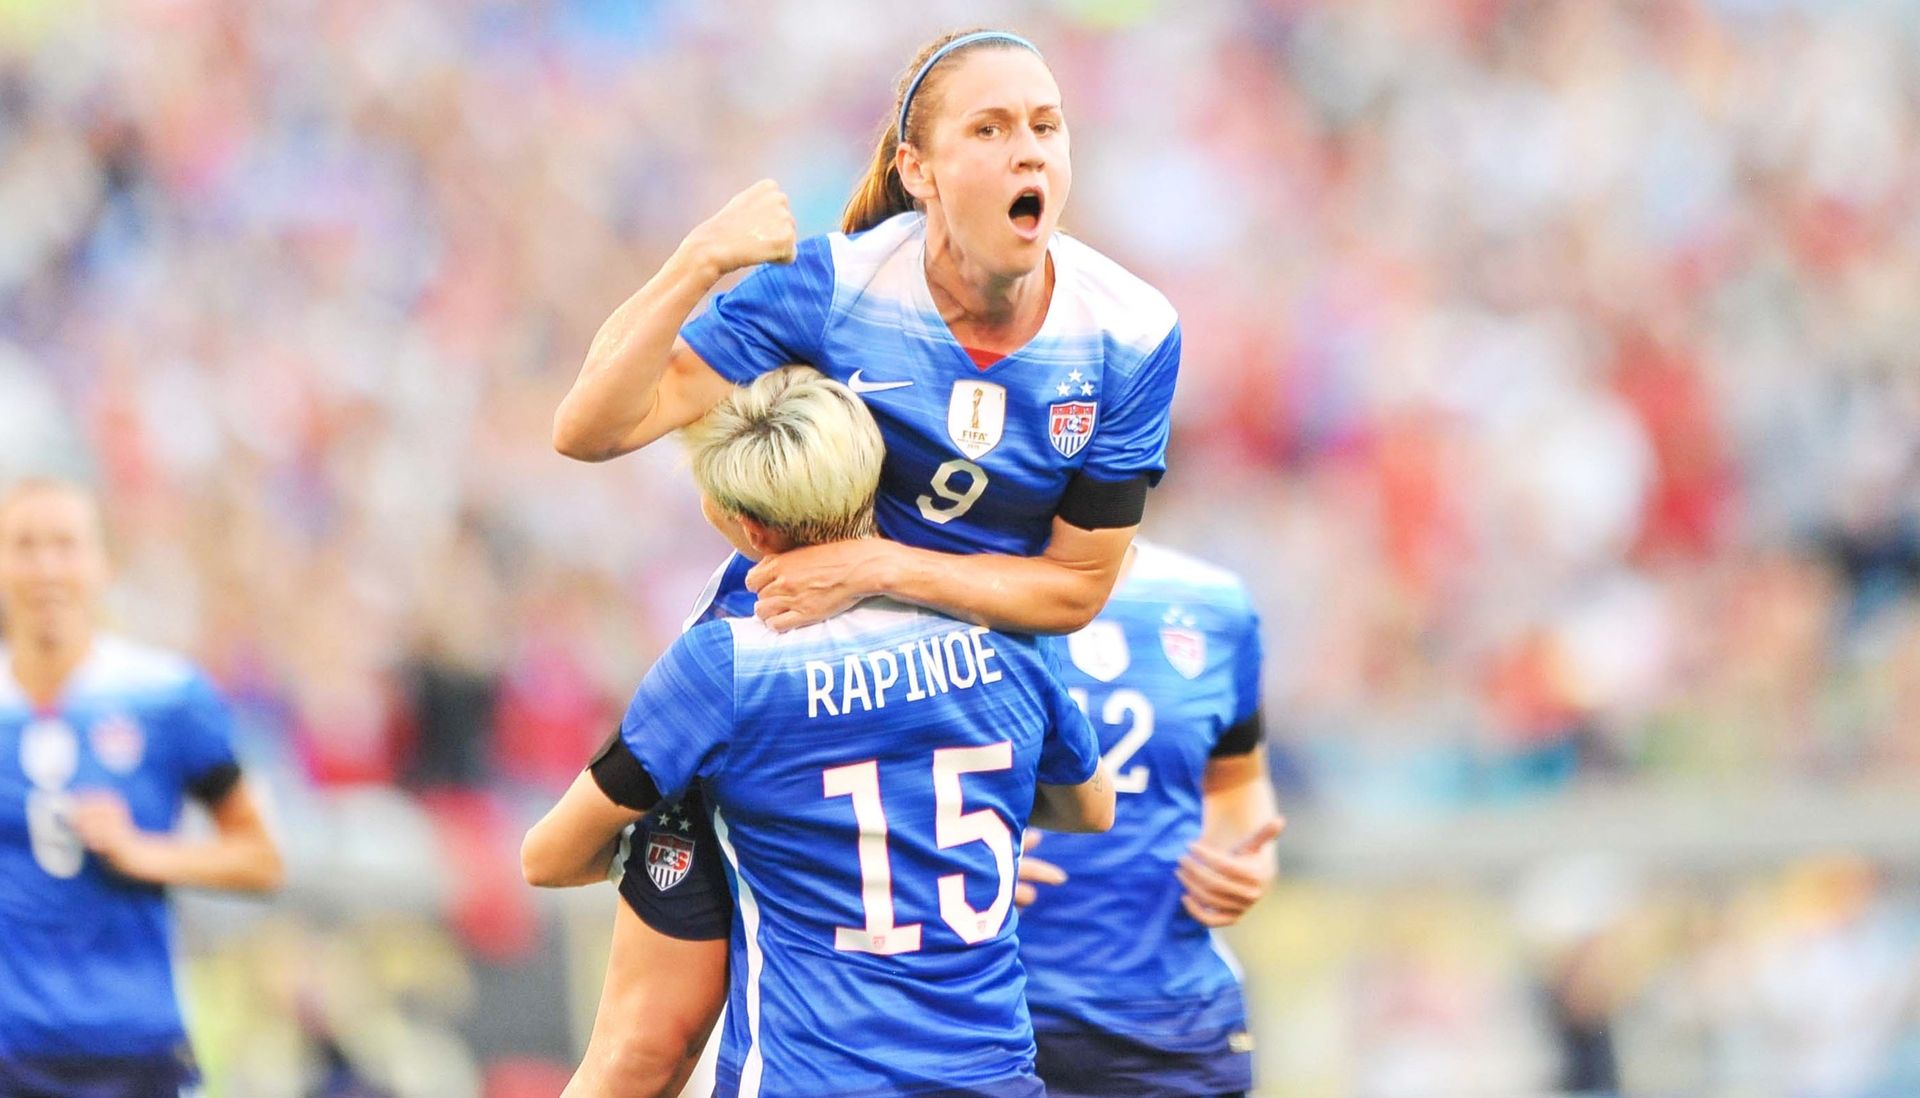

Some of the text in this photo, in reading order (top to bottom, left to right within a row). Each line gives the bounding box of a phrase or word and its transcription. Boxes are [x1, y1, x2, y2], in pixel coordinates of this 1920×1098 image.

[963, 430, 985, 441] FIFA
[916, 458, 989, 524] 9
[805, 627, 1002, 718] RAPINOE
[1067, 688, 1154, 793] 2
[822, 739, 1015, 955] 15
